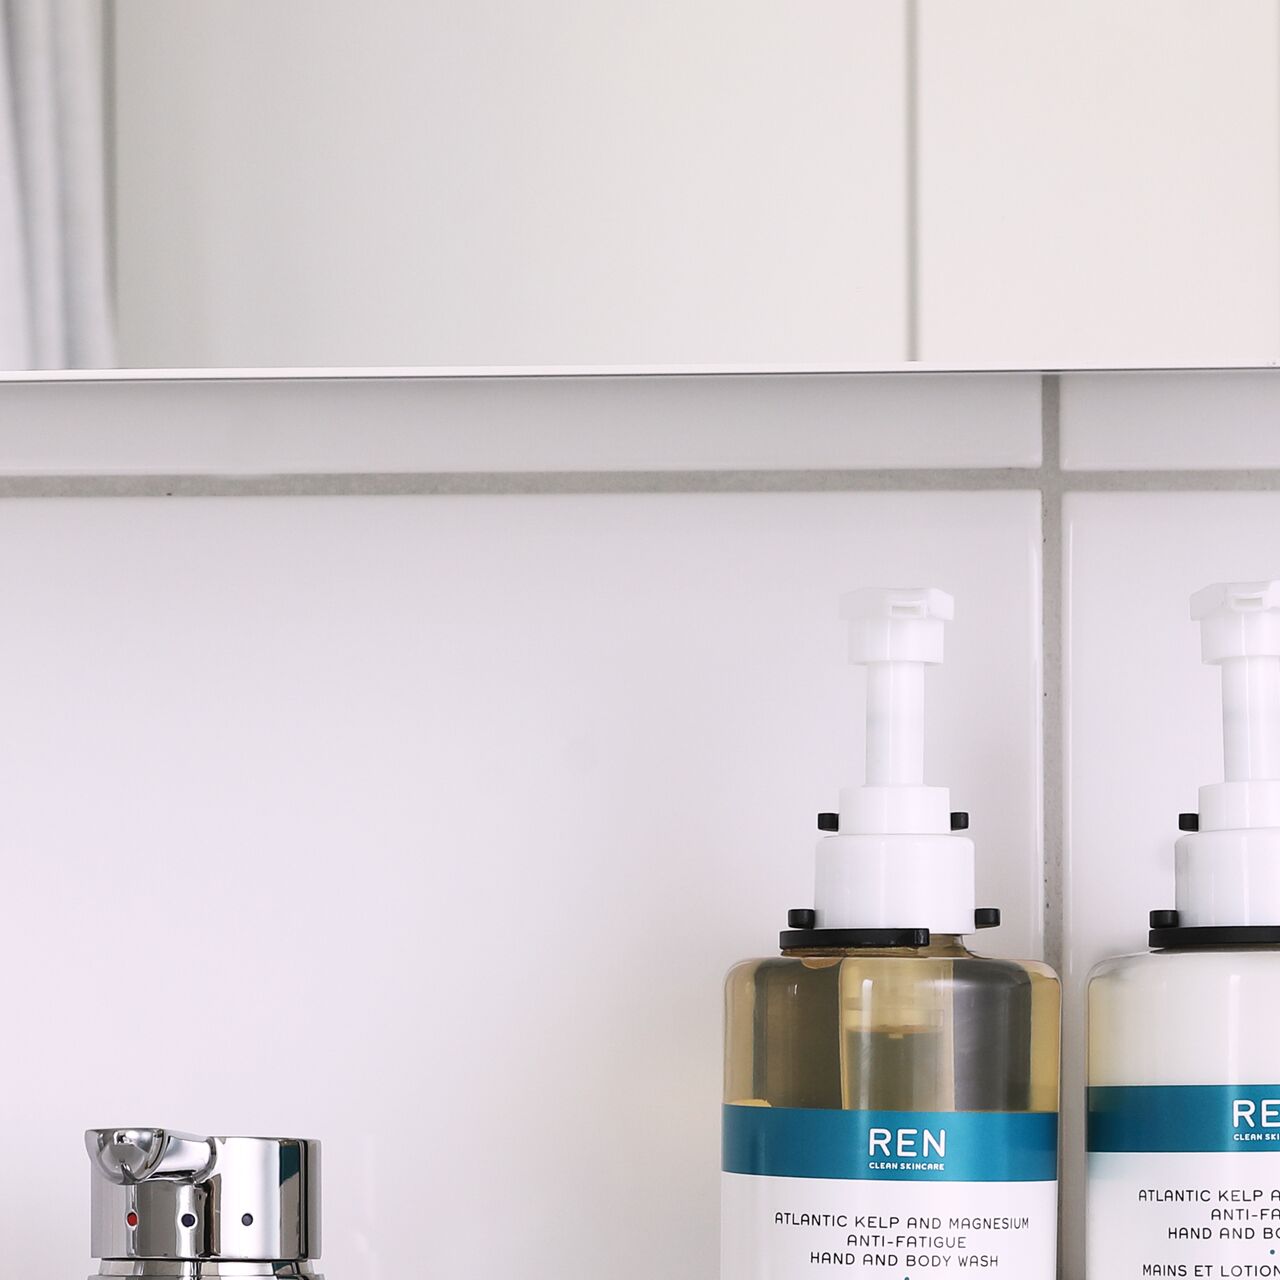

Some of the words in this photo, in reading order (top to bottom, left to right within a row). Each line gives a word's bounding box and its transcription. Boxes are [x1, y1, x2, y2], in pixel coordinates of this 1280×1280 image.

[868, 1127, 947, 1158] REN
[1233, 1133, 1263, 1141] CLEAN
[868, 1161, 899, 1170] CLEAN
[899, 1162, 945, 1171] SKINCARE
[1137, 1189, 1212, 1202] ATLANTIC
[1217, 1189, 1264, 1202] KELP
[774, 1211, 848, 1228] ATLANTIC
[854, 1215, 900, 1230] KELP
[906, 1216, 942, 1230] AND
[948, 1216, 1030, 1230] MAGNESIUM
[1167, 1227, 1213, 1240] HAND
[1219, 1227, 1256, 1240] AND
[846, 1234, 968, 1250] ANTI-FATIGUE
[809, 1251, 856, 1266] HAND
[862, 1253, 899, 1268] AND
[905, 1254, 953, 1268] BODY
[957, 1255, 999, 1268] WASH
[1142, 1263, 1188, 1278] MAINS
[1193, 1264, 1214, 1278] ET
